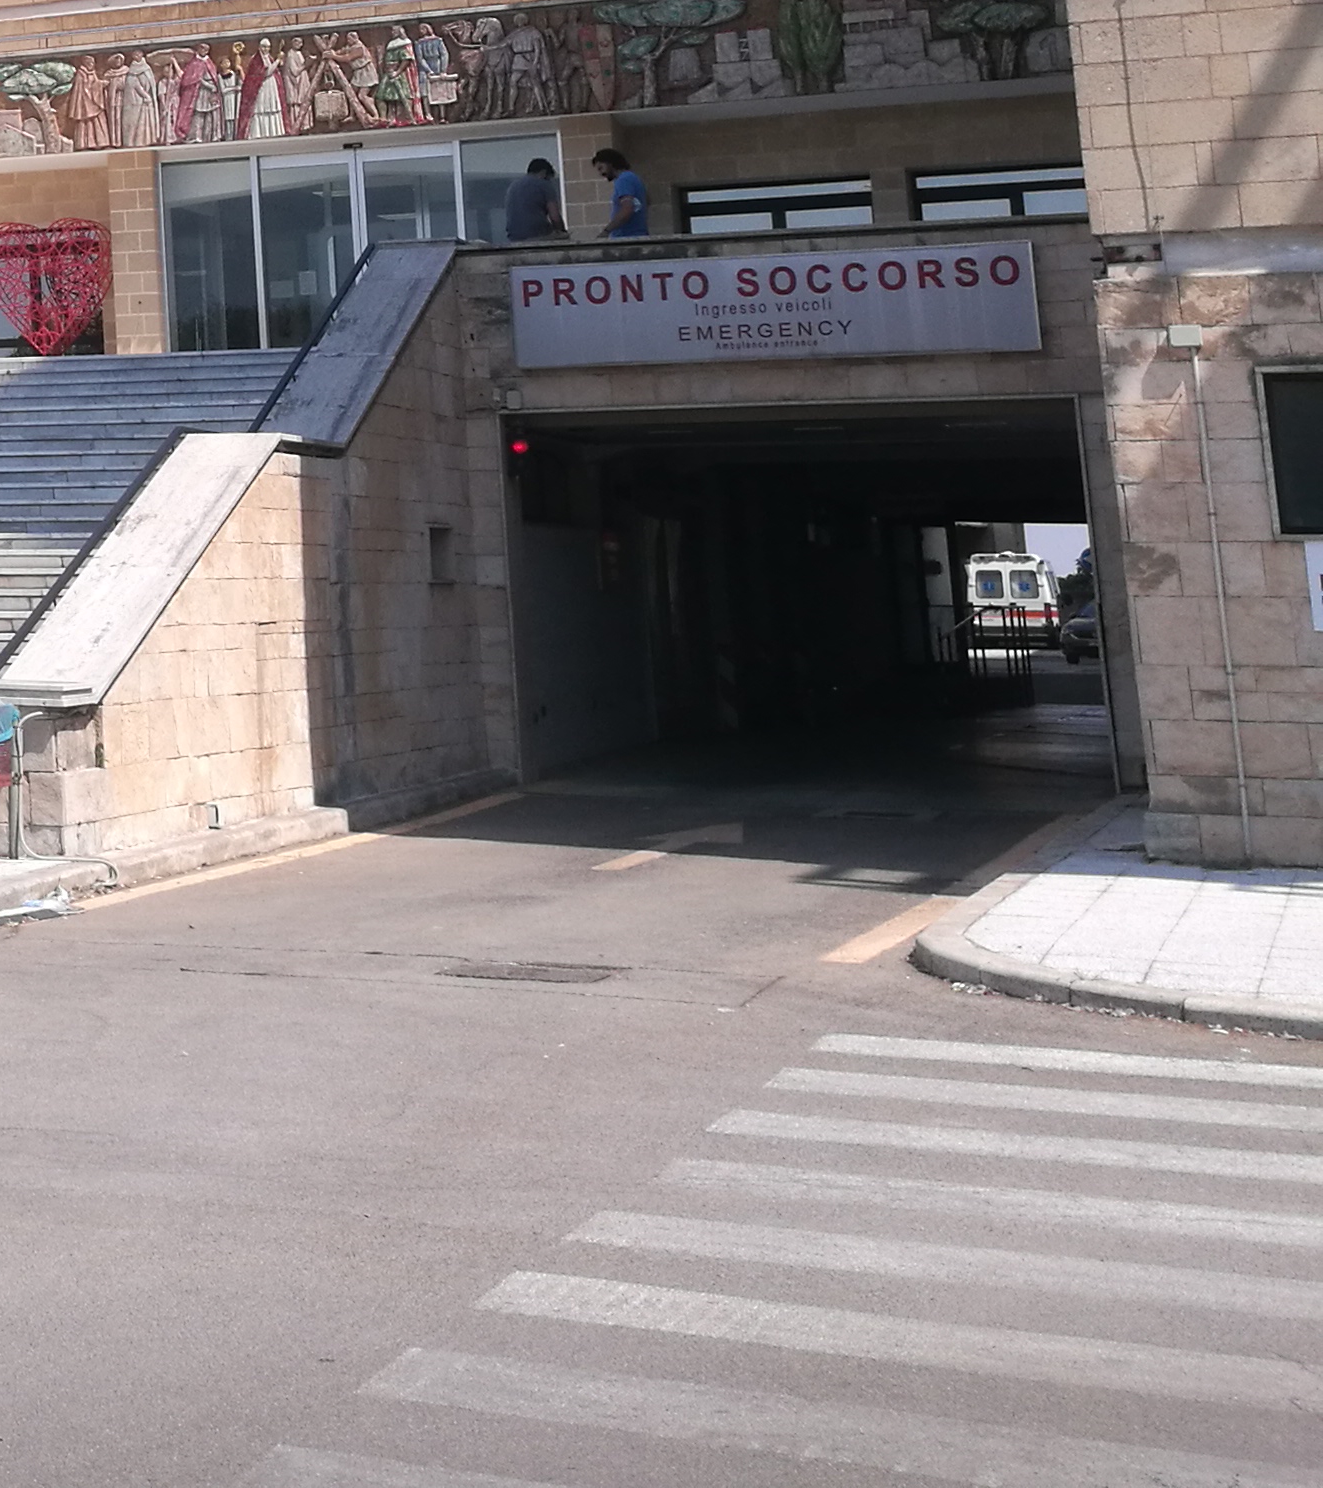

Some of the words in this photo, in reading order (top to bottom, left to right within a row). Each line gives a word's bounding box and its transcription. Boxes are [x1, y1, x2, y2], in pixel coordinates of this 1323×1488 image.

[521, 270, 709, 307] PRONTO
[735, 255, 1020, 297] SOCCORSO
[695, 303, 767, 318] Ingresso
[775, 298, 832, 313] veicoli
[678, 320, 852, 341] EMERGENCY
